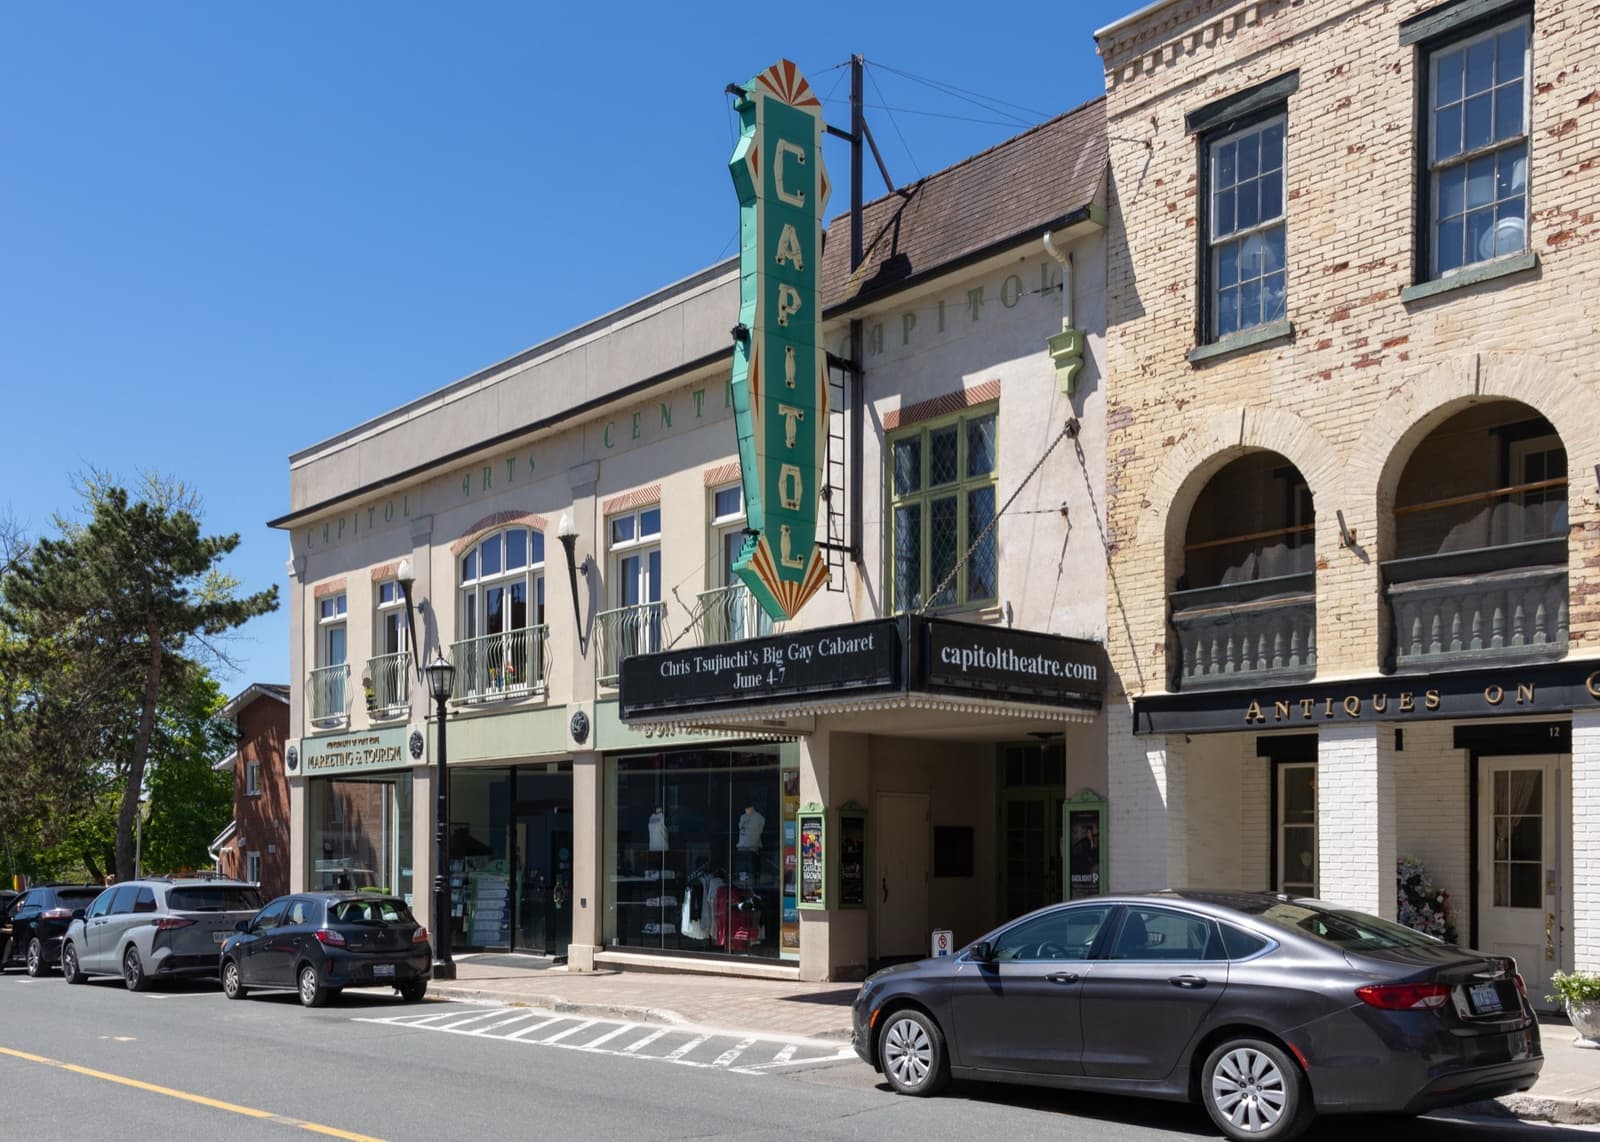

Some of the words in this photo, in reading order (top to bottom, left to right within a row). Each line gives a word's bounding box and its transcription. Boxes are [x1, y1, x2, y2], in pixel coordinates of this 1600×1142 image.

[774, 138, 806, 569] CAPITOL
[306, 495, 411, 550] CAPITOL
[462, 455, 536, 497] ARTS
[660, 660, 691, 677] Chris
[693, 650, 759, 676] Tsujiuchi's
[762, 646, 784, 668] Big
[787, 643, 814, 664] Gay
[818, 633, 874, 657] Cabaret
[941, 644, 1098, 681] capitoltheatre.com
[733, 670, 762, 689] June
[766, 667, 786, 686] 4-7
[1244, 689, 1441, 724] ANTIQUES
[1484, 683, 1536, 706] ON
[1549, 726, 1560, 737] 12
[308, 752, 353, 769] MARKETING
[355, 752, 362, 764] &
[363, 746, 401, 764] TOURISM
